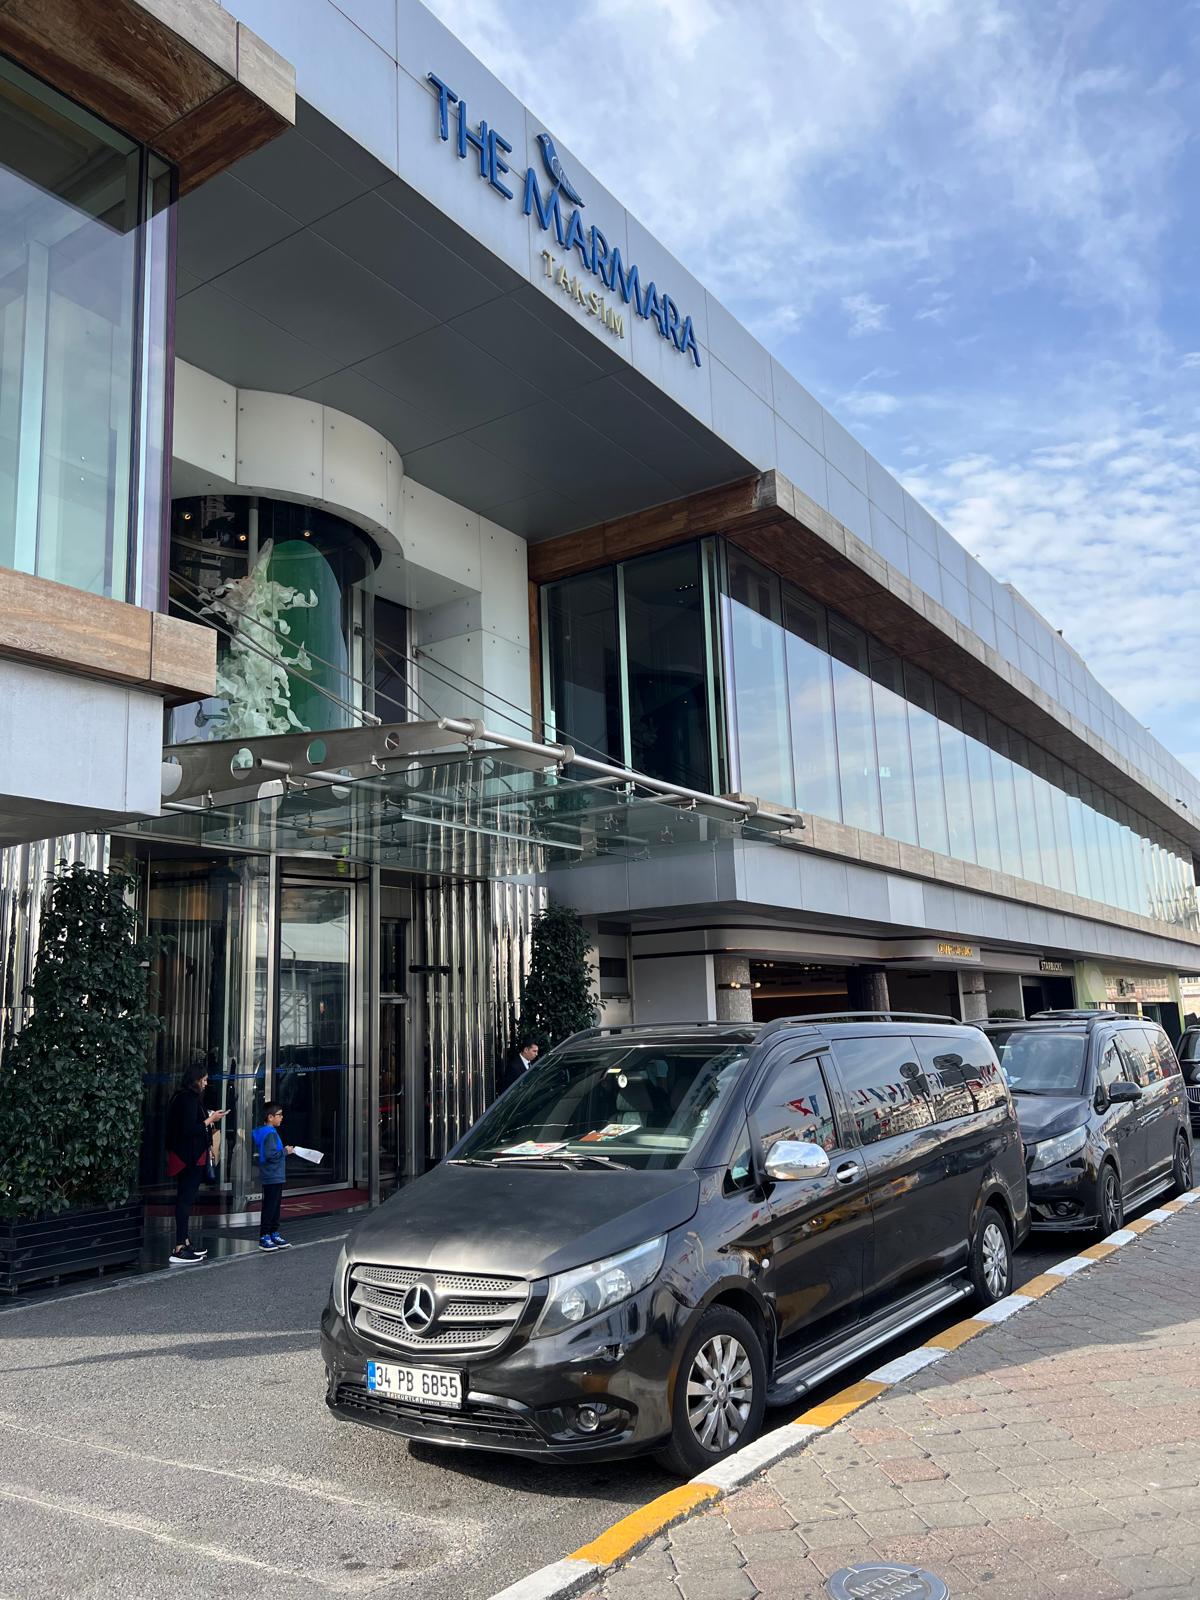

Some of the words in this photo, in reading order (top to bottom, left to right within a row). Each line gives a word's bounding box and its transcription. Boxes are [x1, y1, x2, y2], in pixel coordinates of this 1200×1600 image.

[427, 72, 513, 200] THE
[522, 167, 701, 367] MARMARA
[376, 1366, 391, 1388] 34
[398, 1369, 414, 1392] PB
[422, 1373, 458, 1398] 6855
[849, 1572, 907, 1597] INTER
